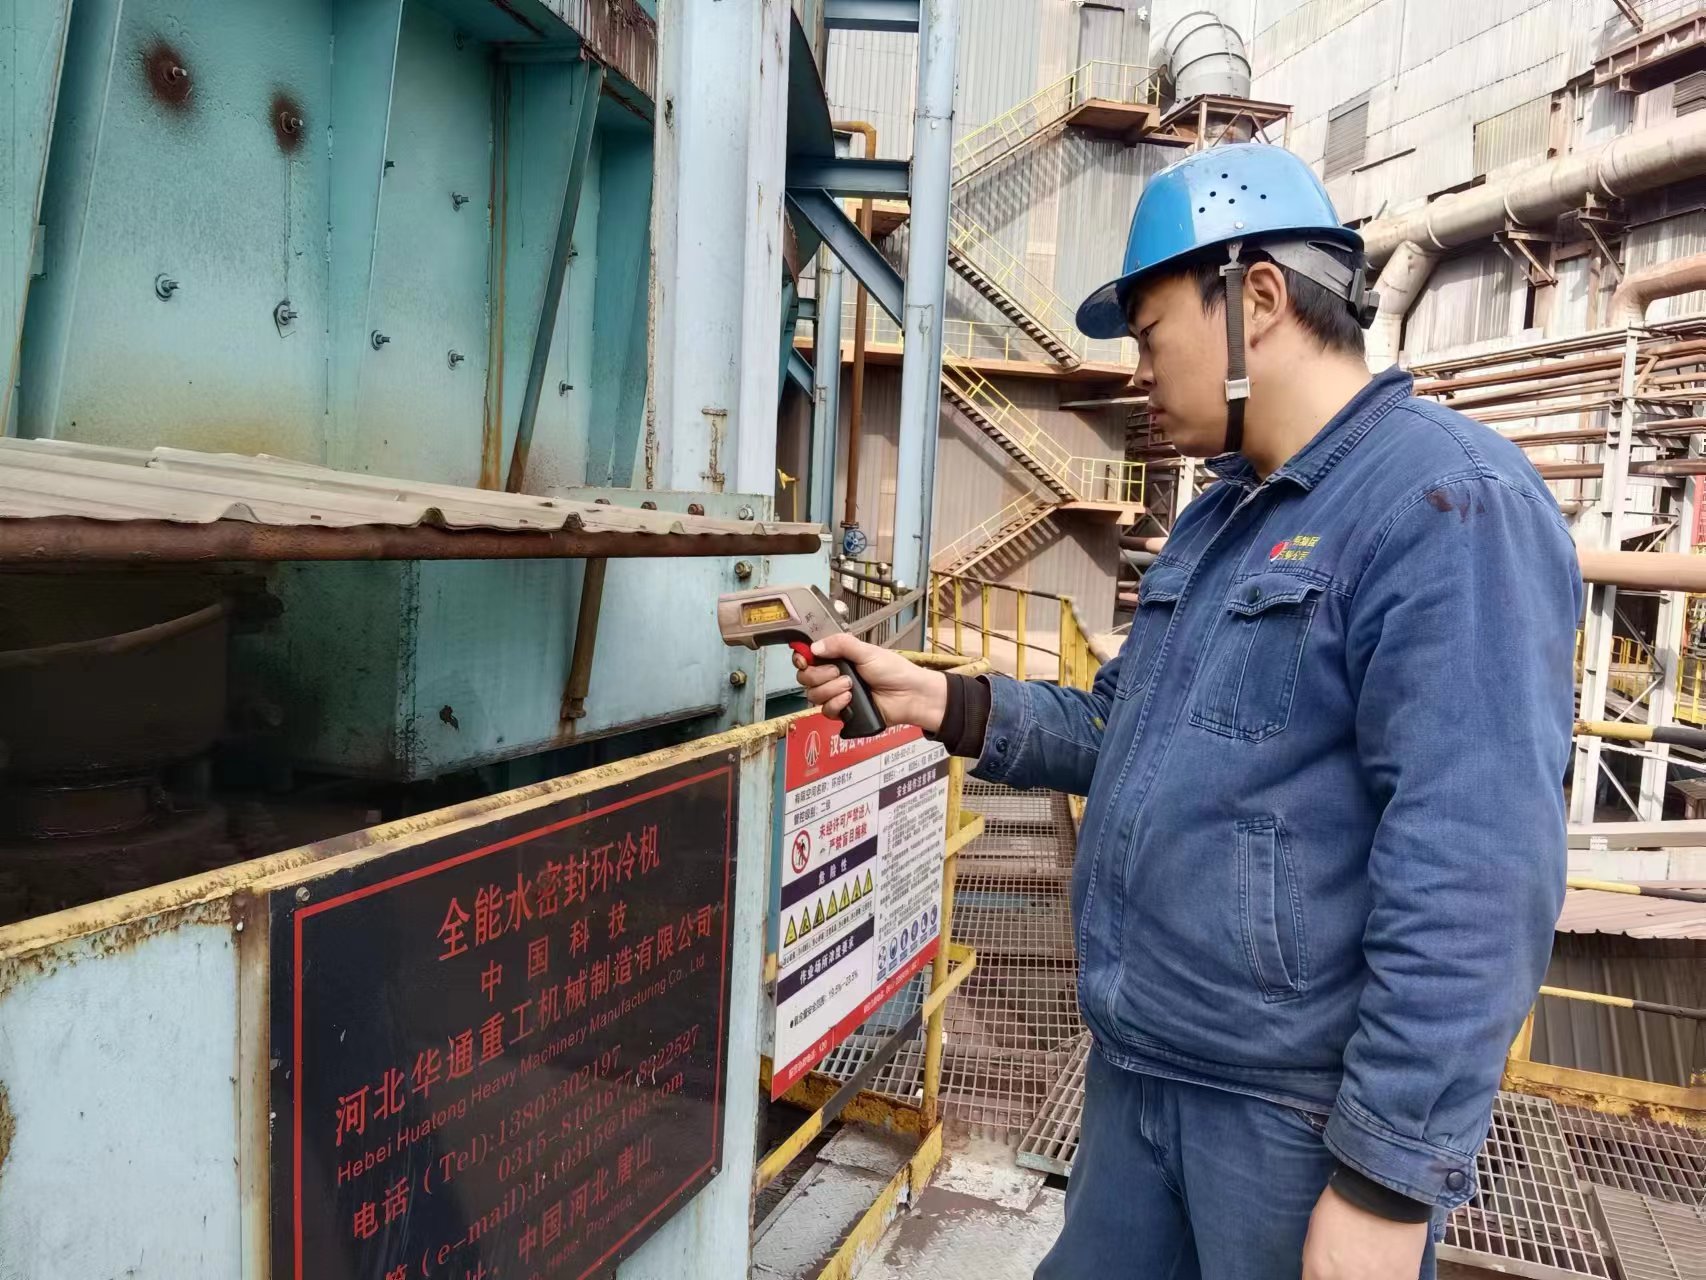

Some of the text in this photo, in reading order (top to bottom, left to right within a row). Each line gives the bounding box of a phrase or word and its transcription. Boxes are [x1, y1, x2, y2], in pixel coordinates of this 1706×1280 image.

[437, 824, 660, 961] 全能水密封环冷机
[818, 857, 848, 886] 危险性
[335, 903, 712, 1147] 河北华通重工机械制造有限公司
[337, 1136, 392, 1187] Hebei
[396, 1097, 467, 1151] Huatong
[470, 1073, 517, 1106] Heavy
[520, 1025, 587, 1075] Machinery
[589, 979, 667, 1031] Manufacturing
